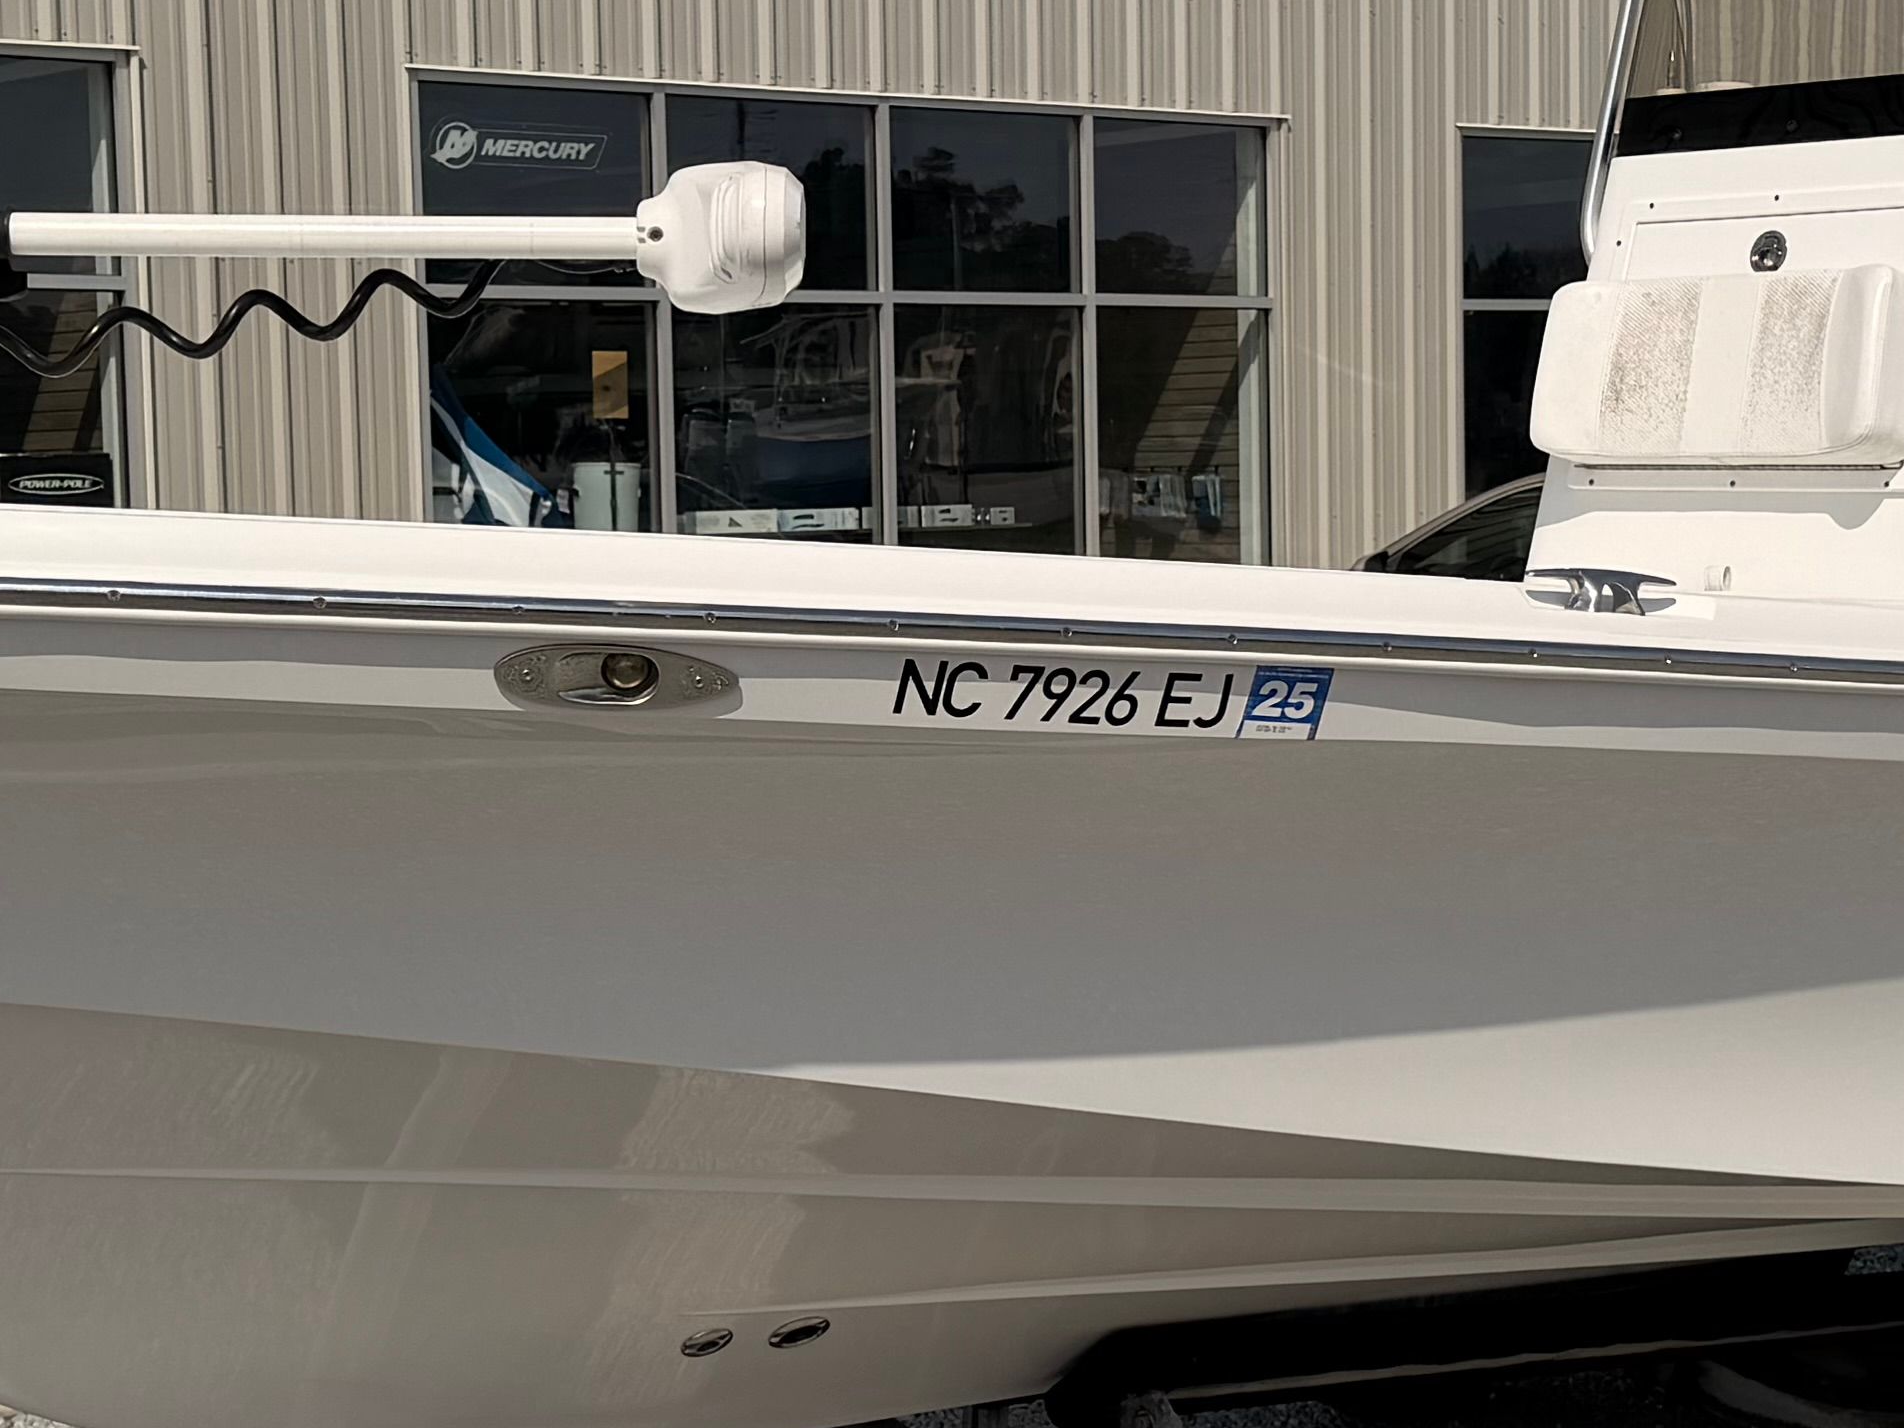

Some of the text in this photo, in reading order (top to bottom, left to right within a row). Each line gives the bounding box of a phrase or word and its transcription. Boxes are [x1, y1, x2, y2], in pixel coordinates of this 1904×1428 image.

[480, 138, 596, 161] MERCURY
[18, 479, 93, 490] POWER-POLE
[892, 658, 1234, 729] NC 7926 EJ
[1251, 680, 1319, 720] 25
